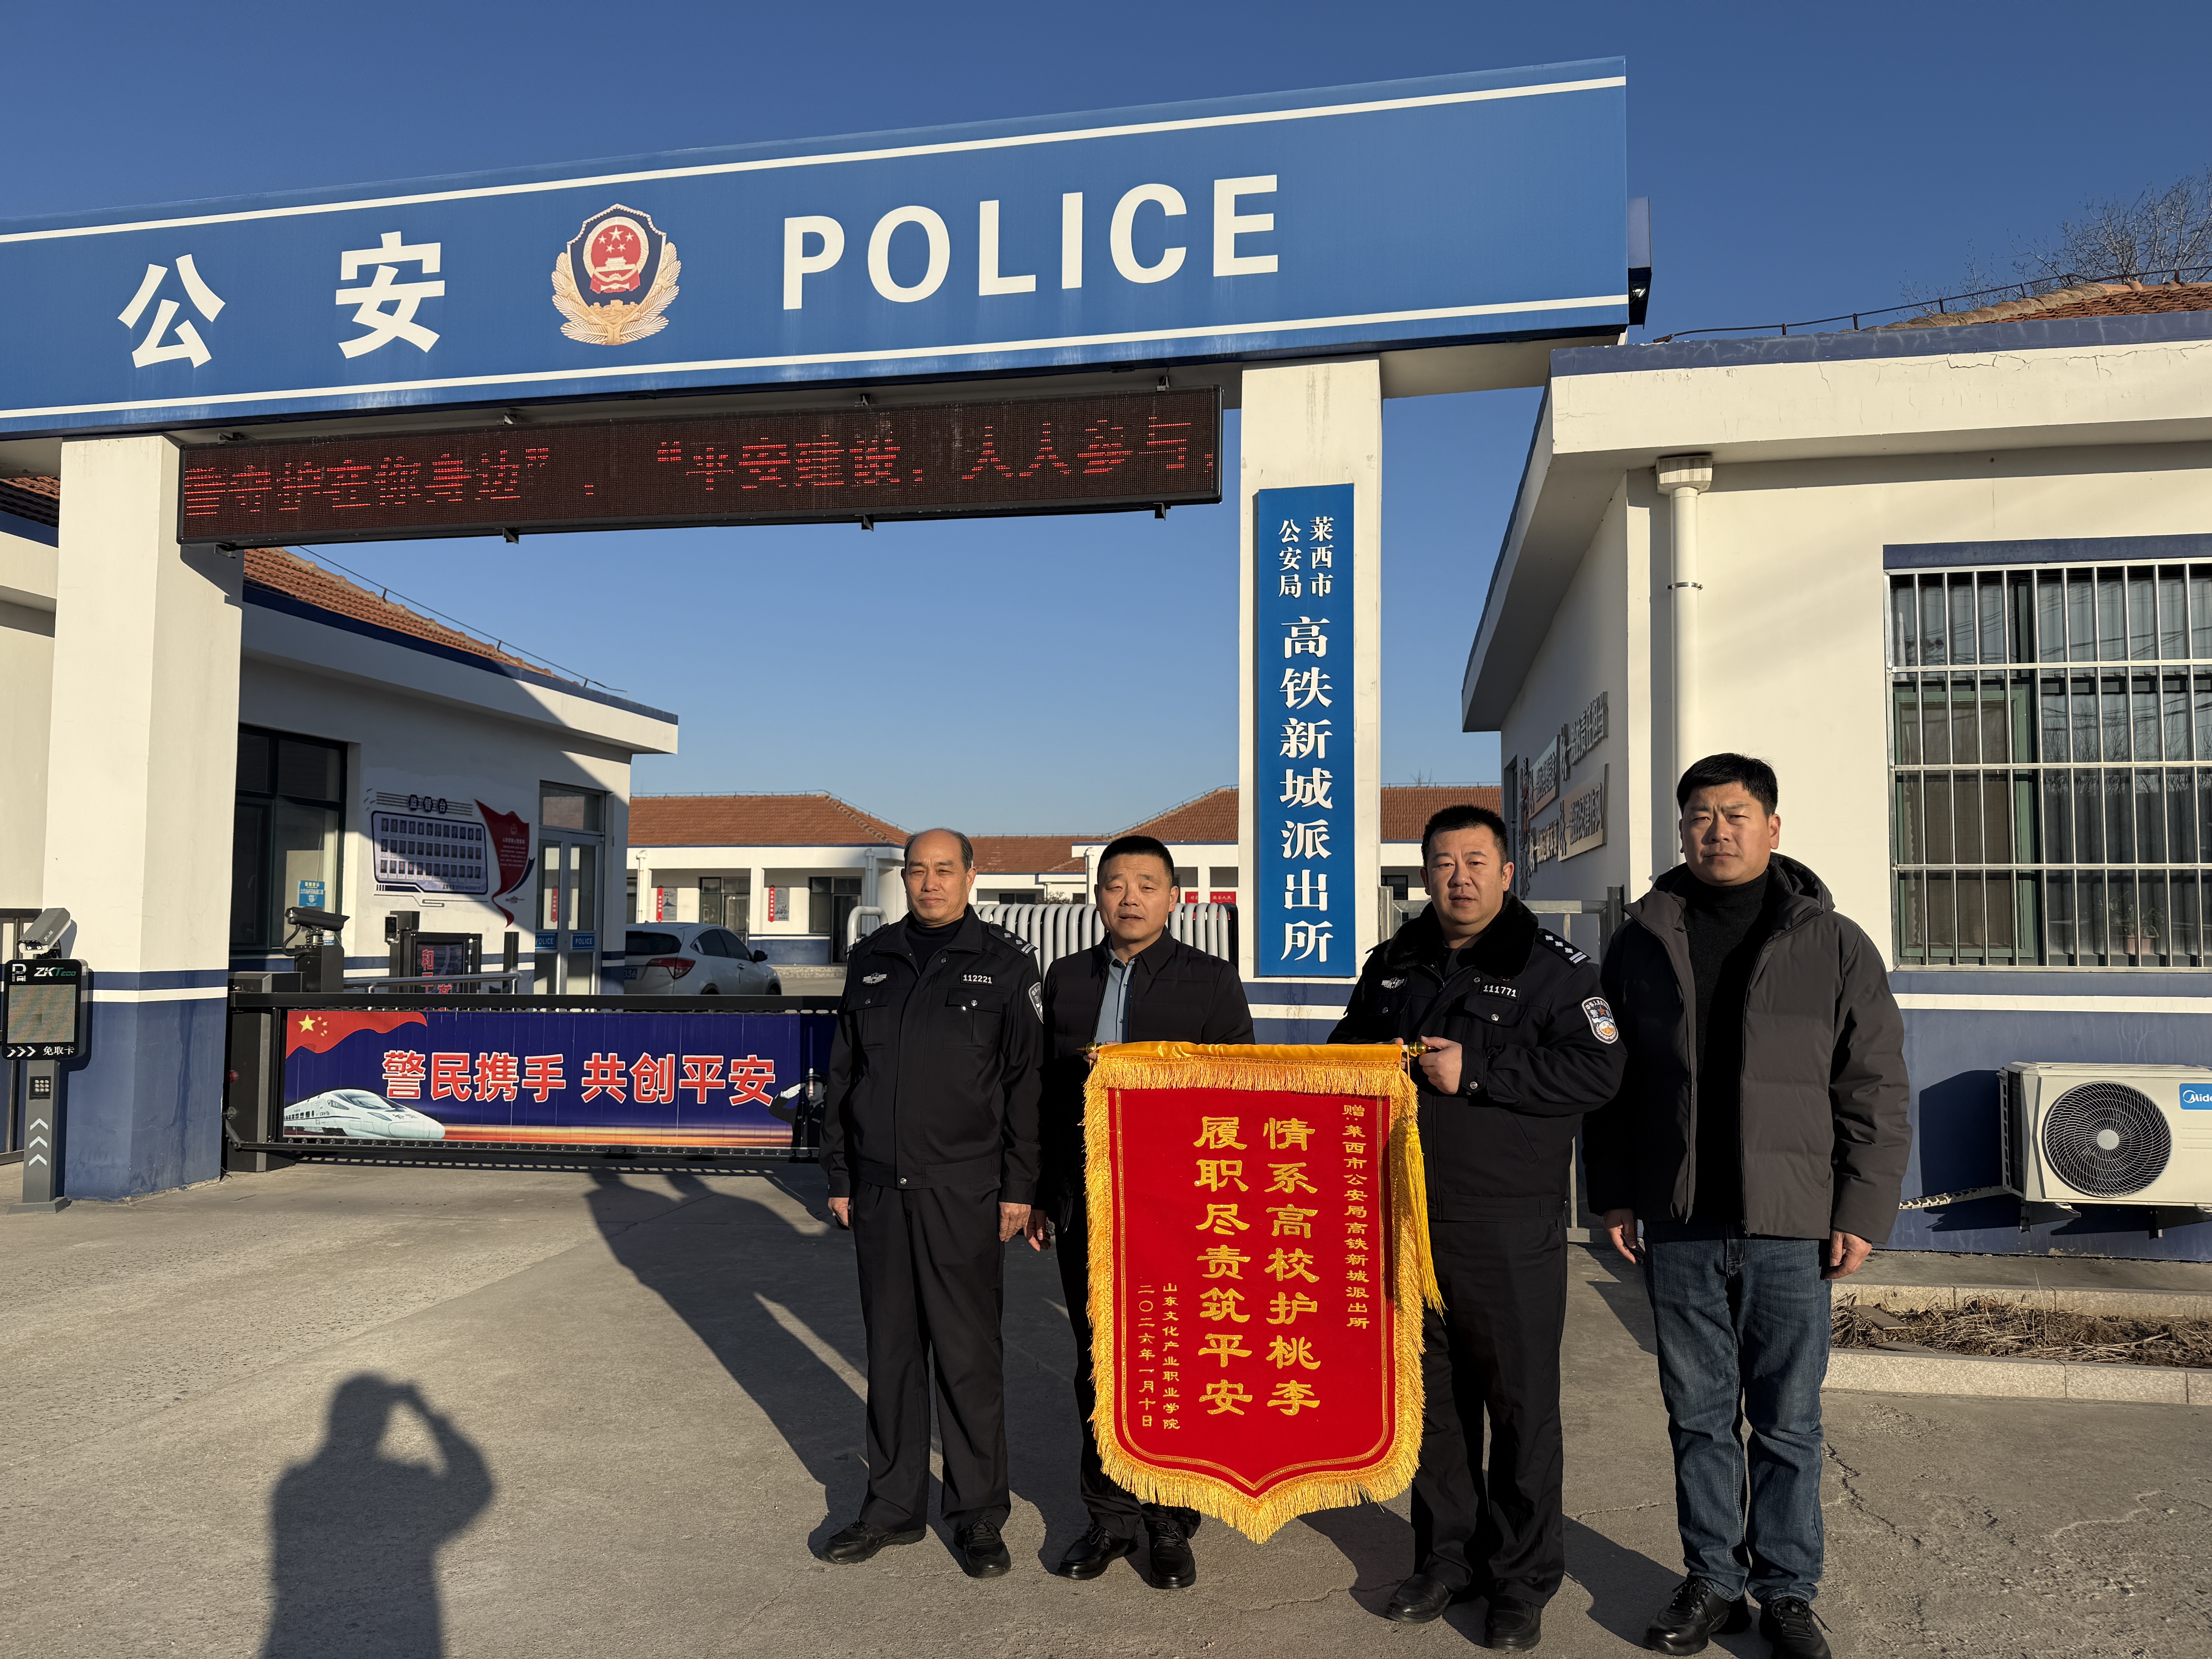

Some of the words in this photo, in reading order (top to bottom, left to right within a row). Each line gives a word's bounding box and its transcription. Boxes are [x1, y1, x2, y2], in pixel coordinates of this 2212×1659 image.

[783, 174, 1281, 310] POLICE
[117, 230, 445, 369] 公安
[1278, 519, 1302, 598] 公安局
[1309, 516, 1334, 597] 莱西市
[410, 796, 446, 812] 监督台
[1279, 616, 1334, 963] 高铁新城派出所
[963, 974, 993, 984] 112221
[1483, 984, 1516, 998] 111771
[43, 1045, 75, 1056] 免取卡
[381, 1049, 567, 1103] 警民携手
[581, 1052, 776, 1107] 共创平安
[1192, 1116, 1253, 1416] 履职尽责筑平安
[1262, 1117, 1321, 1416] 情系高校护桃李
[1162, 1283, 1180, 1430] 山东文化产业职业学院
